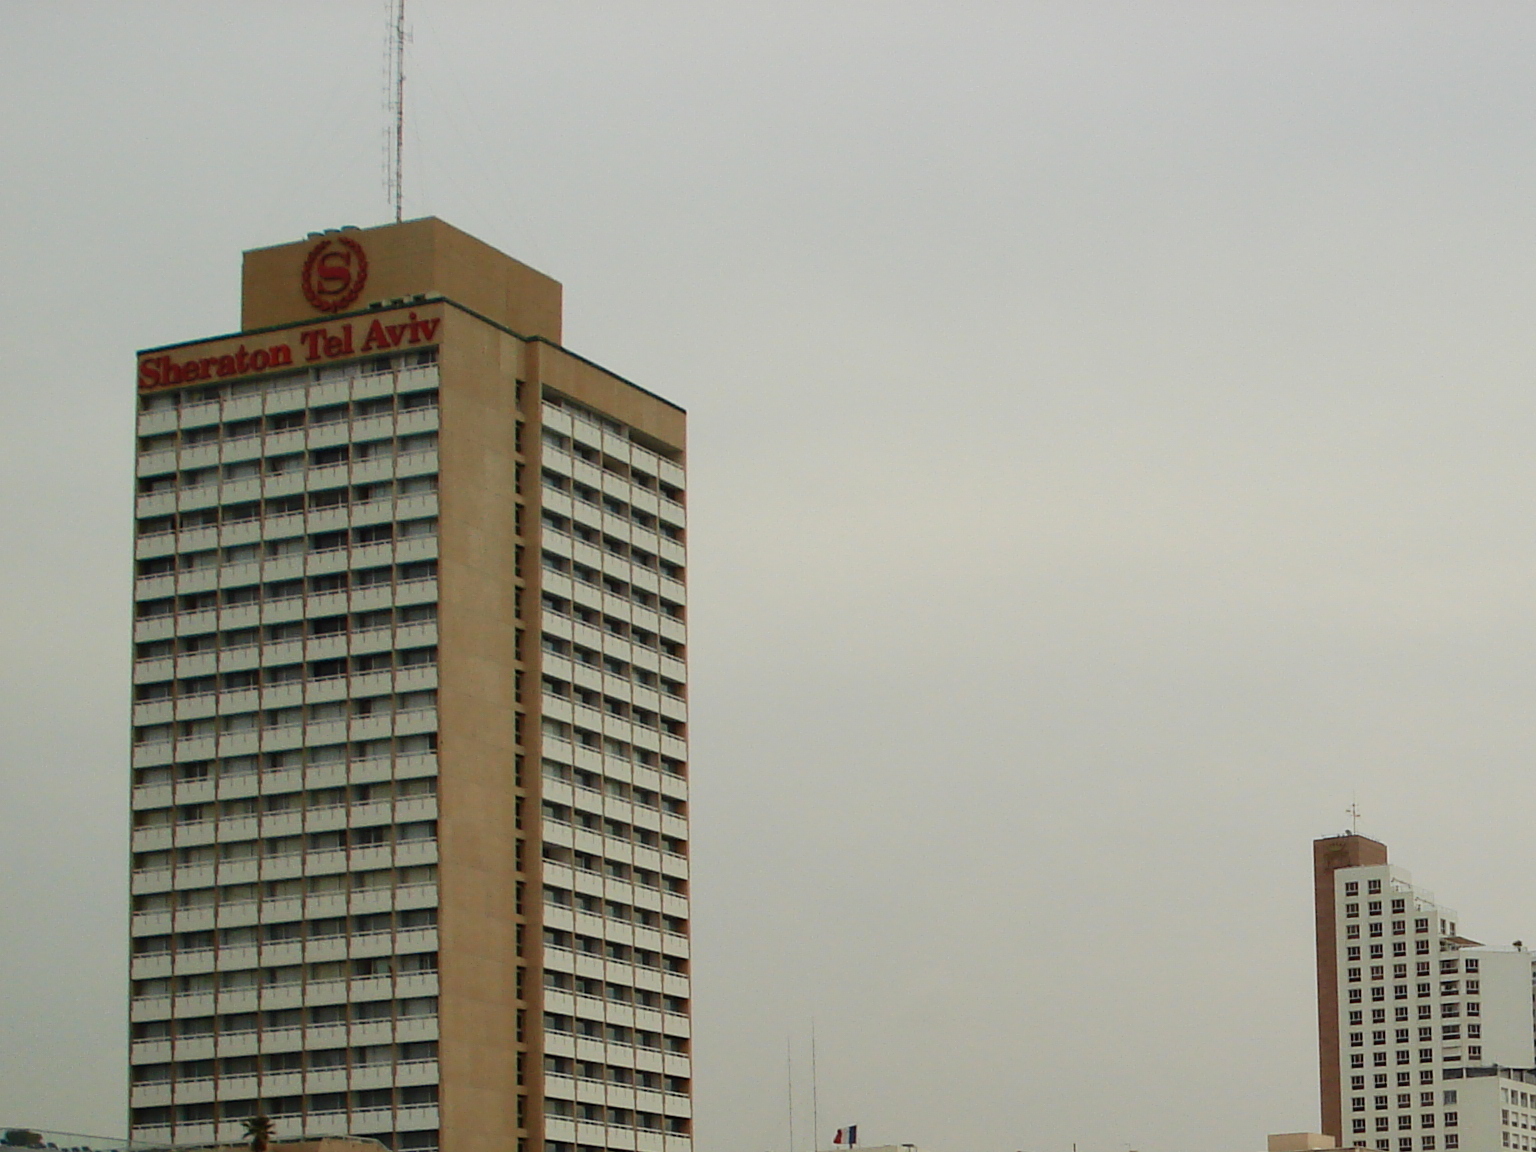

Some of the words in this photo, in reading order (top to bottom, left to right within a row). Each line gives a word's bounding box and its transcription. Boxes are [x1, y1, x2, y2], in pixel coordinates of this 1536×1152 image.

[316, 251, 351, 295] S
[138, 344, 293, 388] Sheraton
[301, 323, 355, 362] Tel
[361, 311, 441, 351] Aviv
